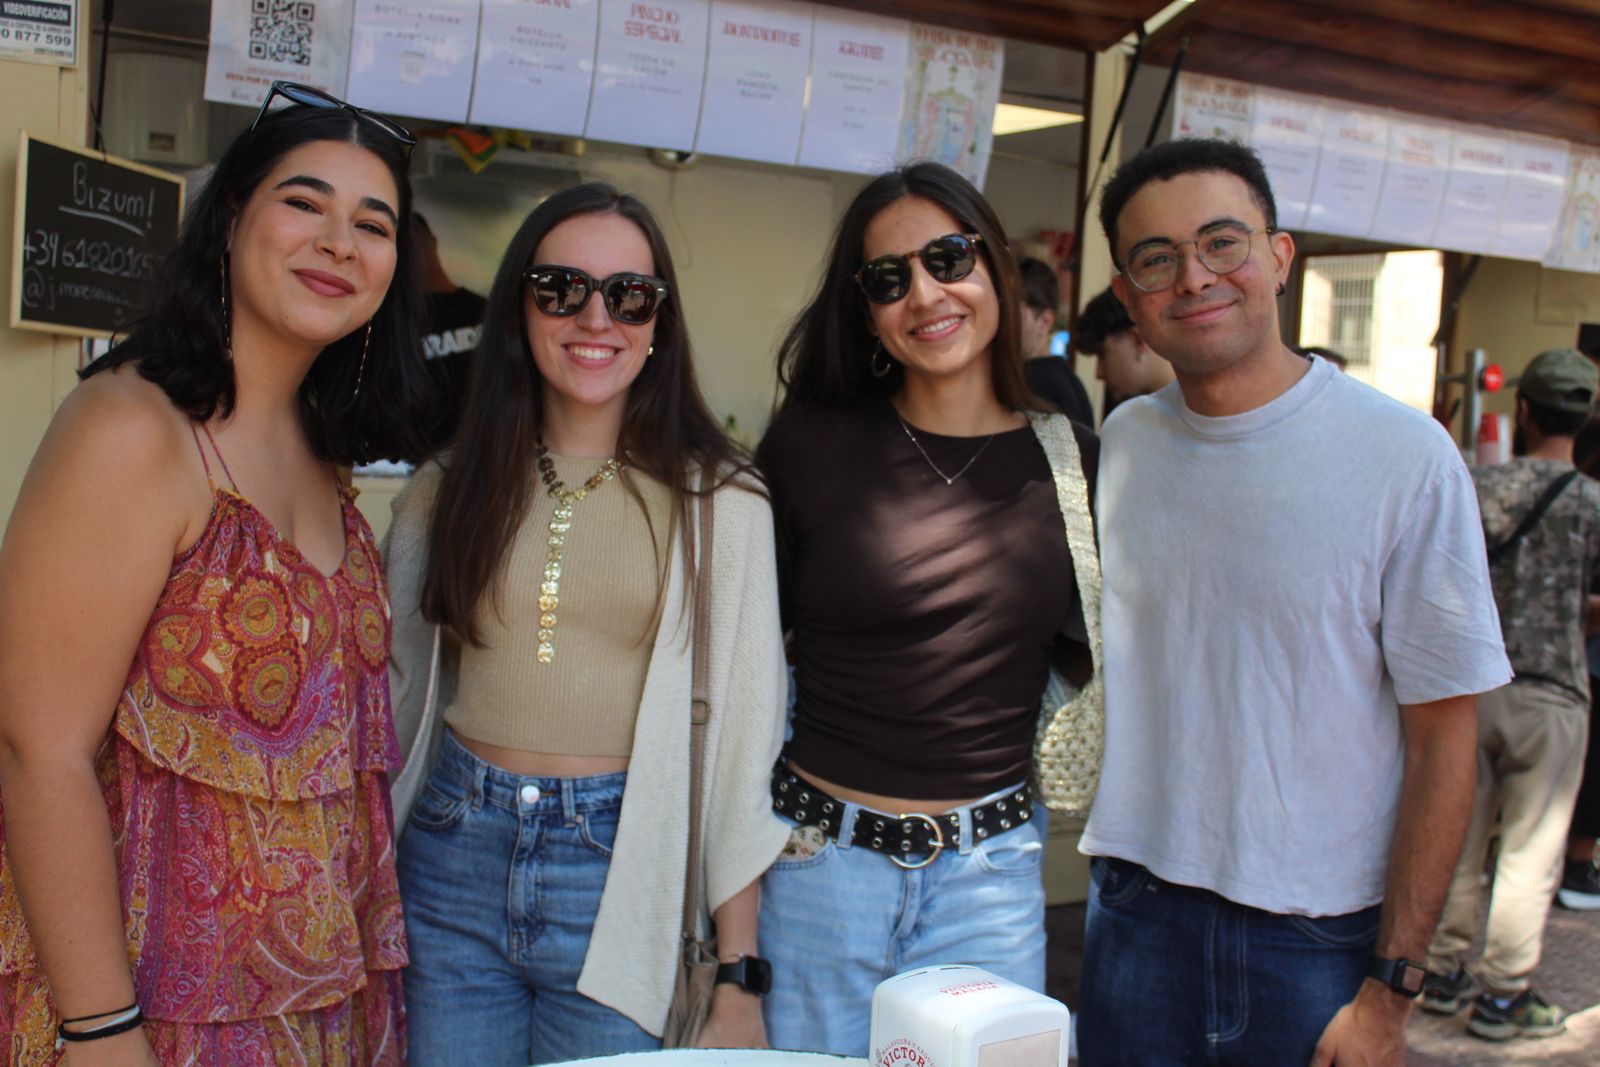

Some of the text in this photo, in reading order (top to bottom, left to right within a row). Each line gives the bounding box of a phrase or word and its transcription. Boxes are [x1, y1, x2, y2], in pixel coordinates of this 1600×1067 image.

[15, 30, 41, 43] 877
[45, 33, 72, 47] 599
[939, 980, 995, 994] VICTORIA
